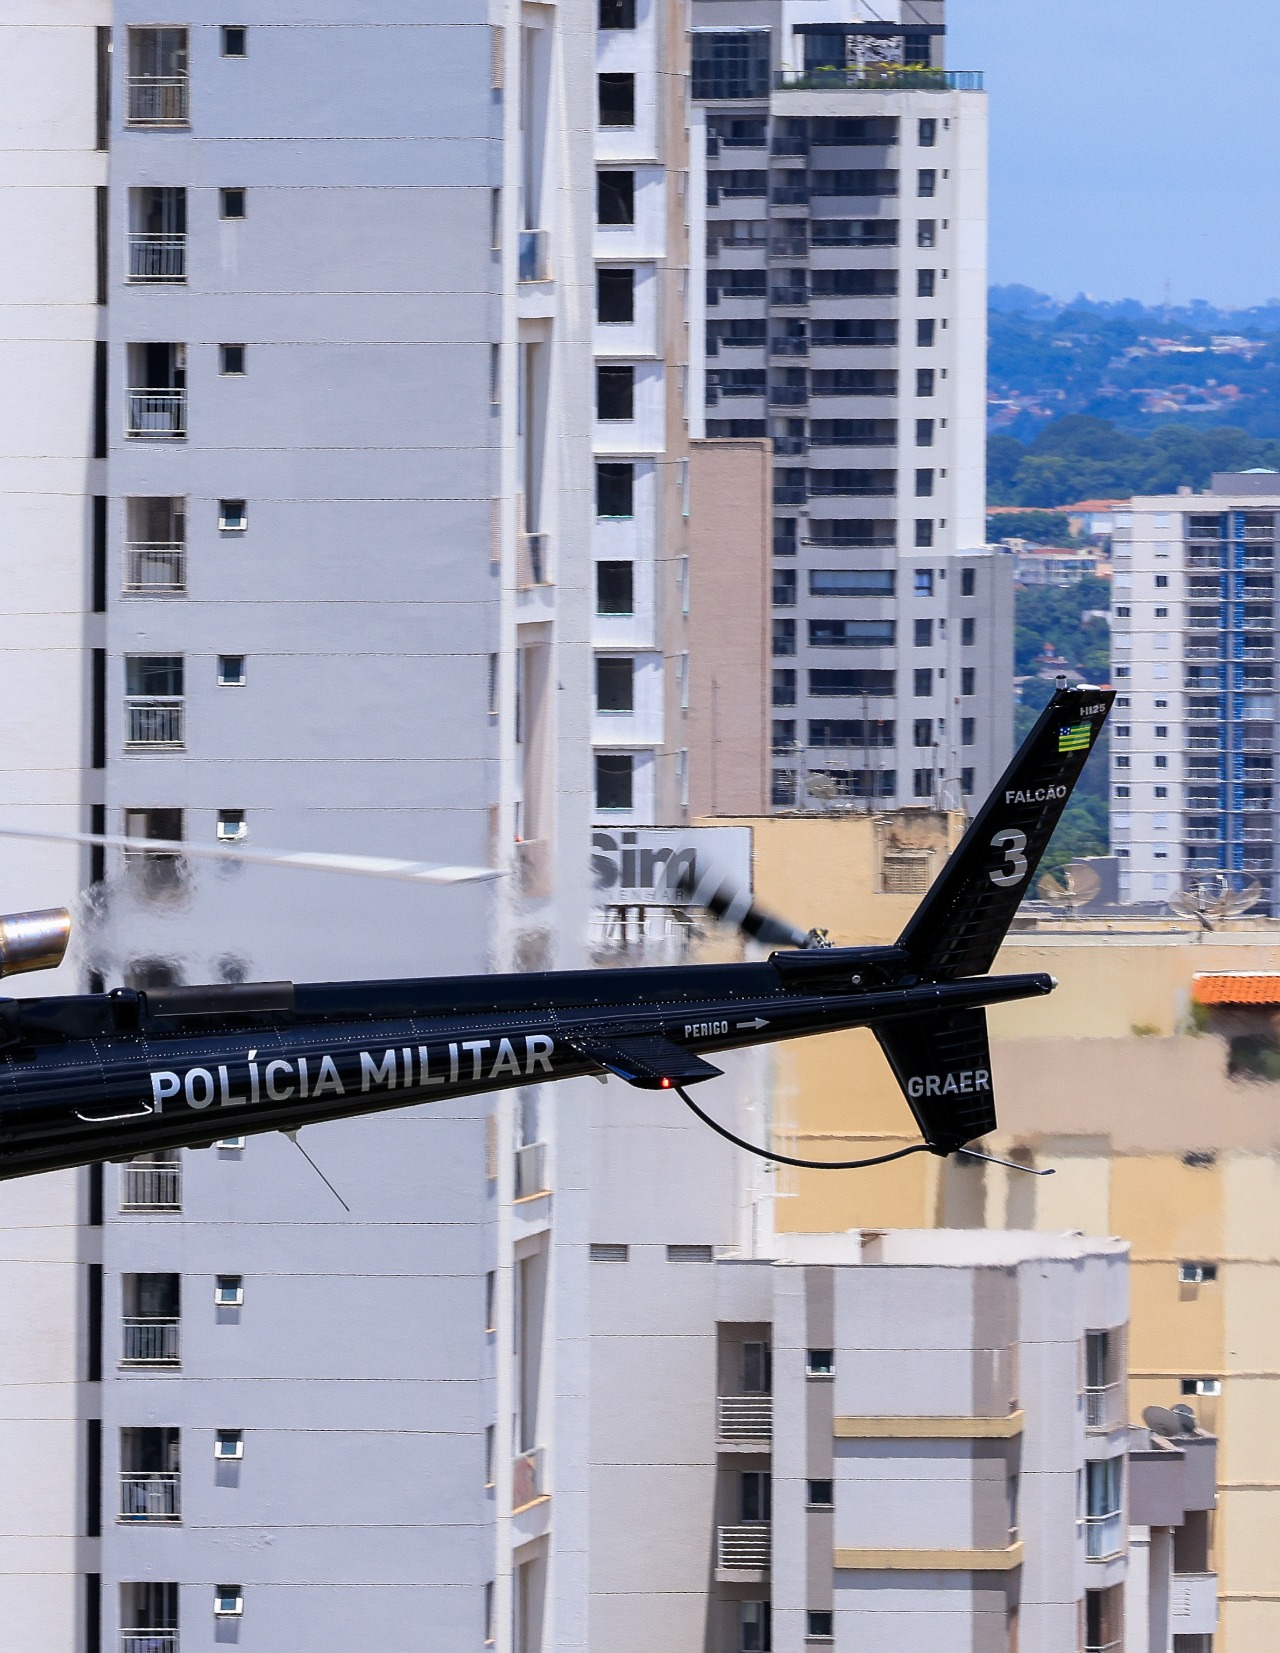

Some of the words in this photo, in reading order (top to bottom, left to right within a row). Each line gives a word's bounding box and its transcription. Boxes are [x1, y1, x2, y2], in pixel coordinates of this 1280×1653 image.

[1005, 784, 1067, 804] FALCÃO
[989, 828, 1028, 887] 3
[684, 1020, 729, 1039] PERIGO
[150, 1050, 346, 1114] POLÍCIA
[359, 1034, 555, 1093] MILITAR
[907, 1069, 991, 1098] GRAER
